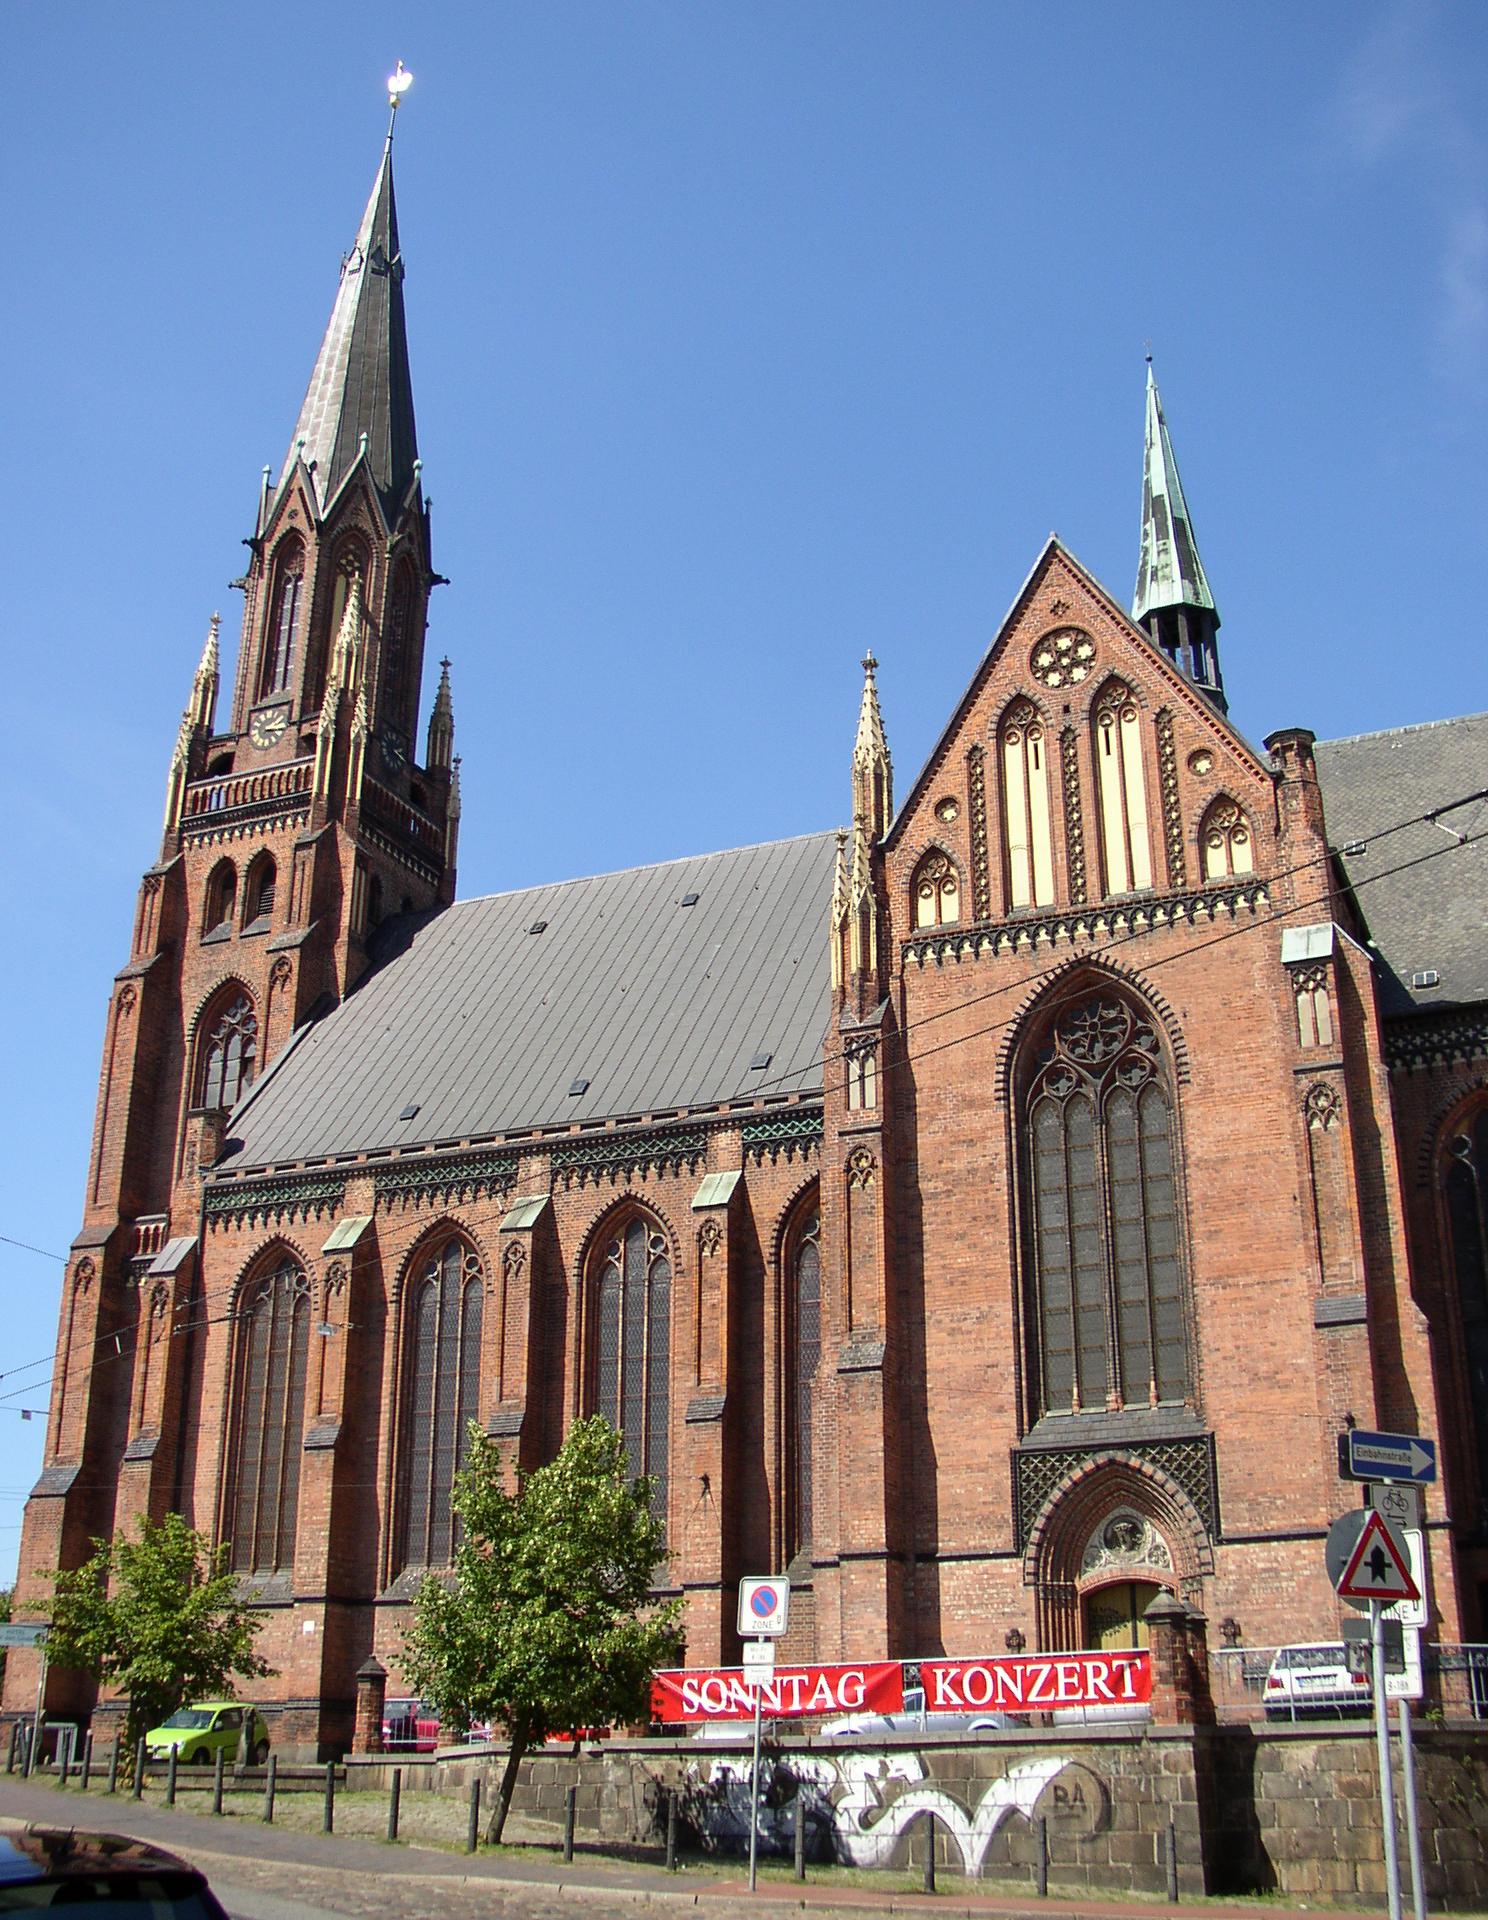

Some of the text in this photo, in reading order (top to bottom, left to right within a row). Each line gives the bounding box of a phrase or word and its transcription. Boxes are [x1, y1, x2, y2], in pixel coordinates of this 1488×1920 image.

[1356, 1446, 1412, 1463] Einbahnstraße
[752, 1620, 775, 1630] ZONE
[682, 1671, 867, 1714] SONNTAG
[932, 1658, 1142, 1706] KONZERT
